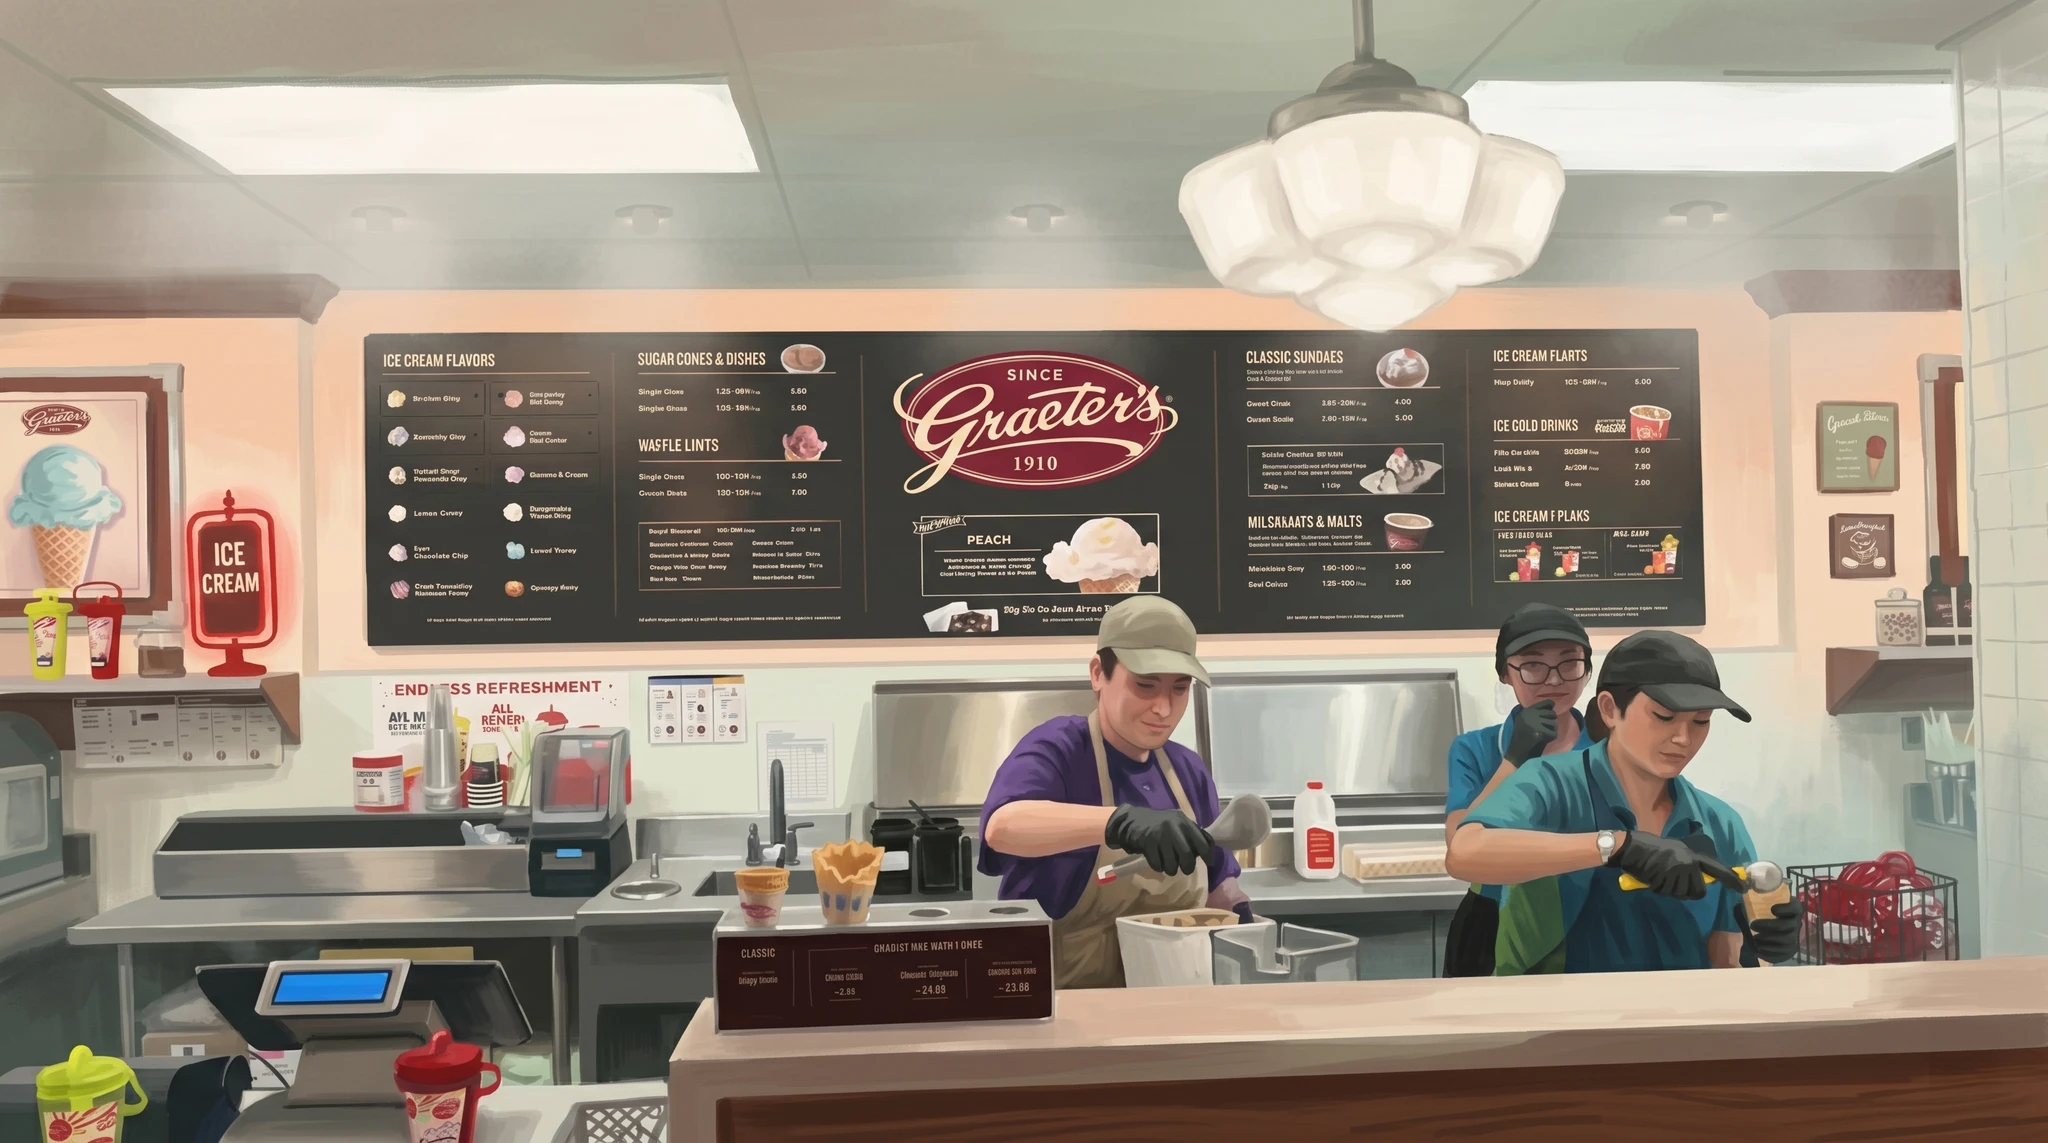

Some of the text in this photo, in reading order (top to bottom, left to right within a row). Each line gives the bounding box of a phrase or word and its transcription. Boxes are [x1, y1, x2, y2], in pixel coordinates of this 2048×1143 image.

[383, 353, 495, 367] ICE CREAM FLAVORS
[637, 352, 766, 366] SUGAR CONES & DISHES
[1246, 350, 1344, 364] CLASSIC SUNDAES
[1493, 349, 1588, 362] ICE CREAM FLARTS
[1007, 369, 1063, 381] SINCE
[1493, 420, 1509, 432] ICE
[1541, 419, 1578, 432] DRINKS
[893, 373, 1179, 494] Graeter's
[685, 438, 719, 452] LINTS
[1014, 456, 1058, 471] 1910
[1316, 515, 1325, 528] &
[1327, 515, 1363, 528] MALTS
[1494, 510, 1510, 523] ICE
[1513, 510, 1548, 523] CREAM
[1558, 510, 1590, 522] PLAKS
[967, 535, 1012, 545] PEACH
[213, 541, 246, 567] ICE
[201, 572, 260, 595] CREAM
[395, 681, 602, 696] ENDSS REFRESHMENT
[491, 704, 514, 714] ALL
[931, 941, 953, 951] WATH
[741, 948, 776, 959] CLASSIC
